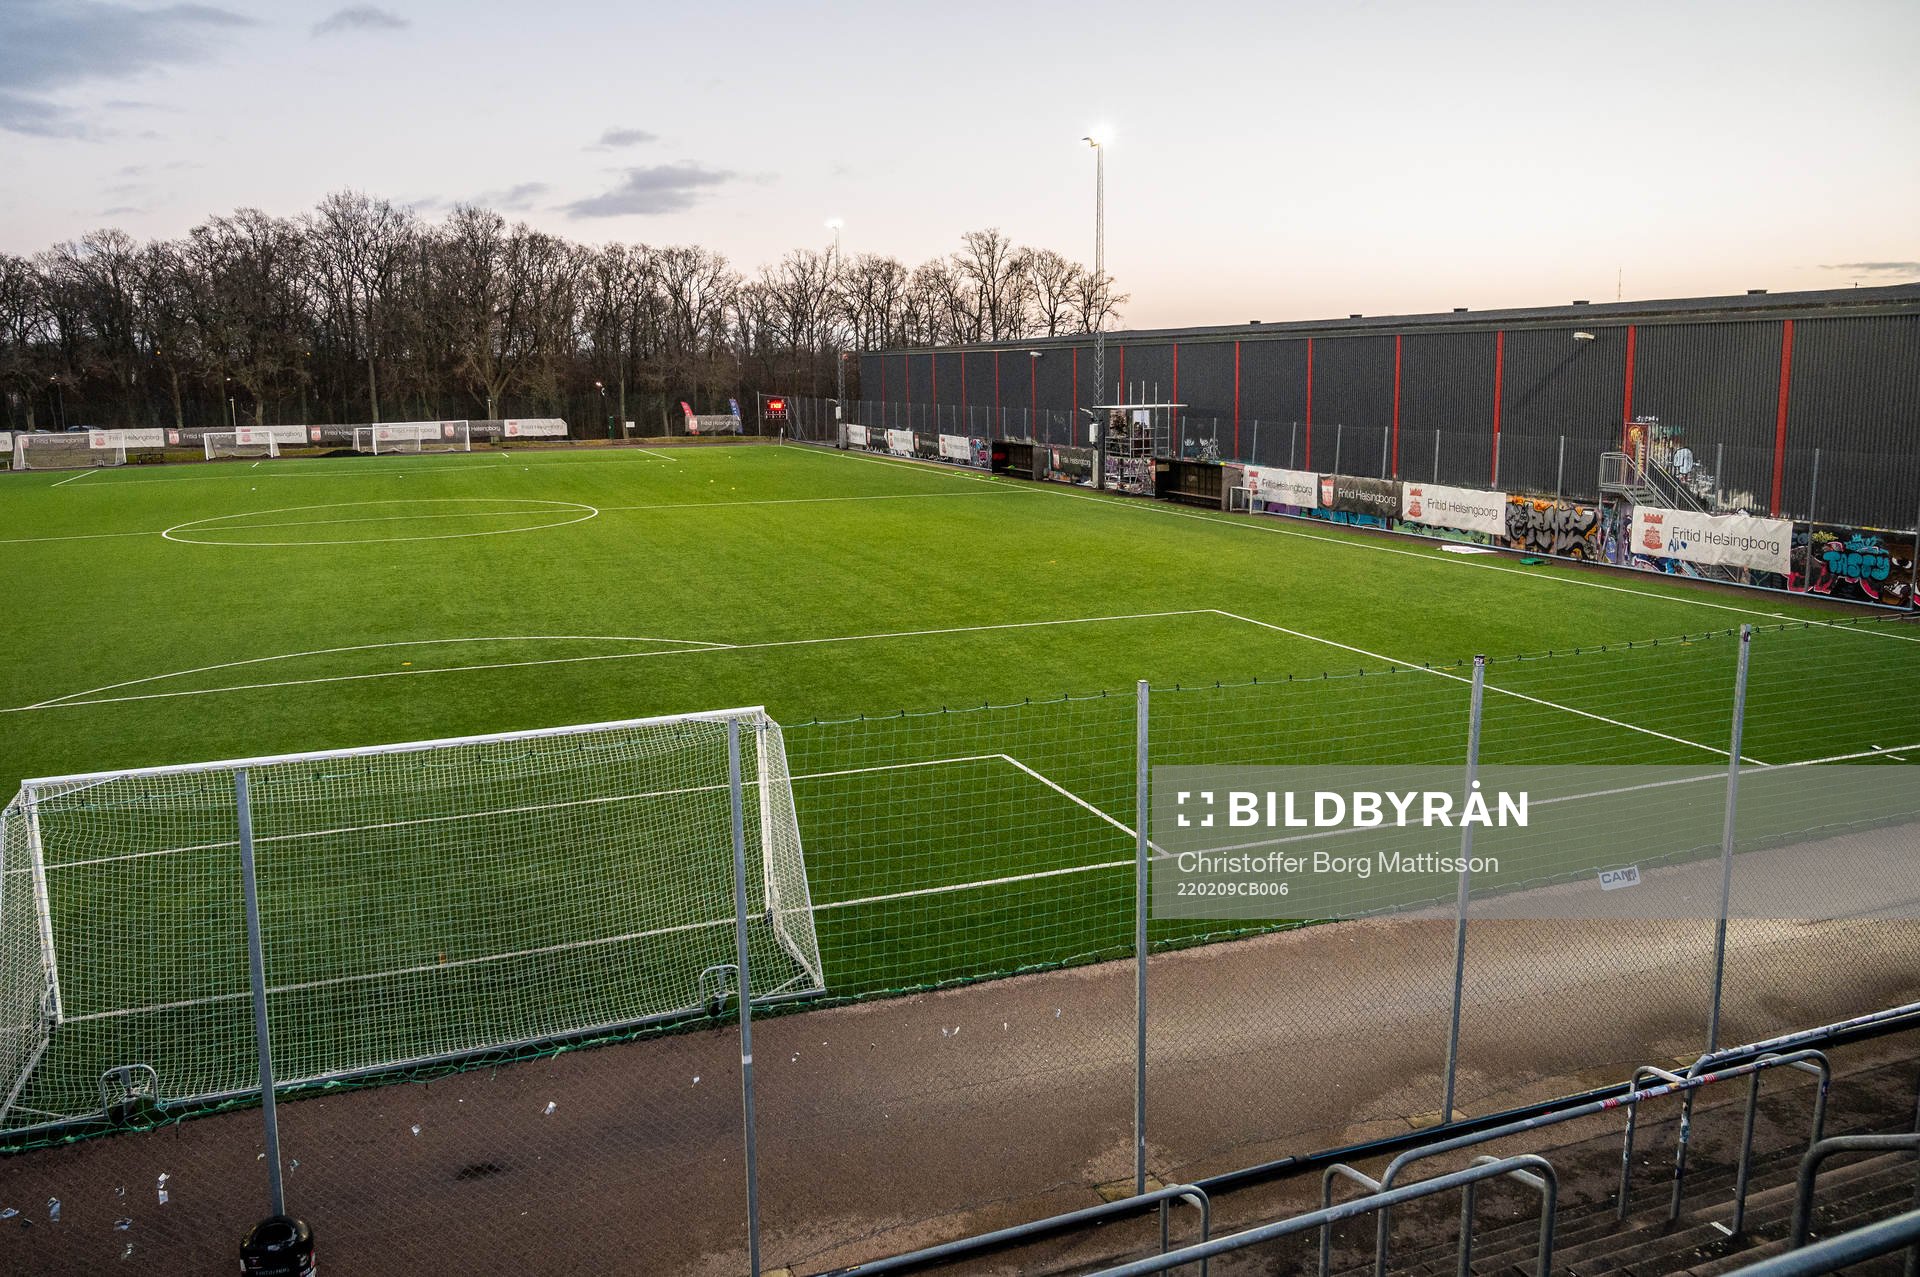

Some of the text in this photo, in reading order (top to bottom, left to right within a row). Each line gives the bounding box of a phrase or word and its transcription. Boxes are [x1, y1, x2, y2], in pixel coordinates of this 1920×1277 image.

[1261, 478, 1313, 497] Fritid Helsingborg
[1337, 487, 1397, 507] Fritid Helsingborg
[1427, 498, 1498, 520] Fritid Helsingborg
[1672, 526, 1701, 543] Fritid
[1704, 530, 1780, 555] Helsingborg
[1823, 551, 1890, 580] TASTY
